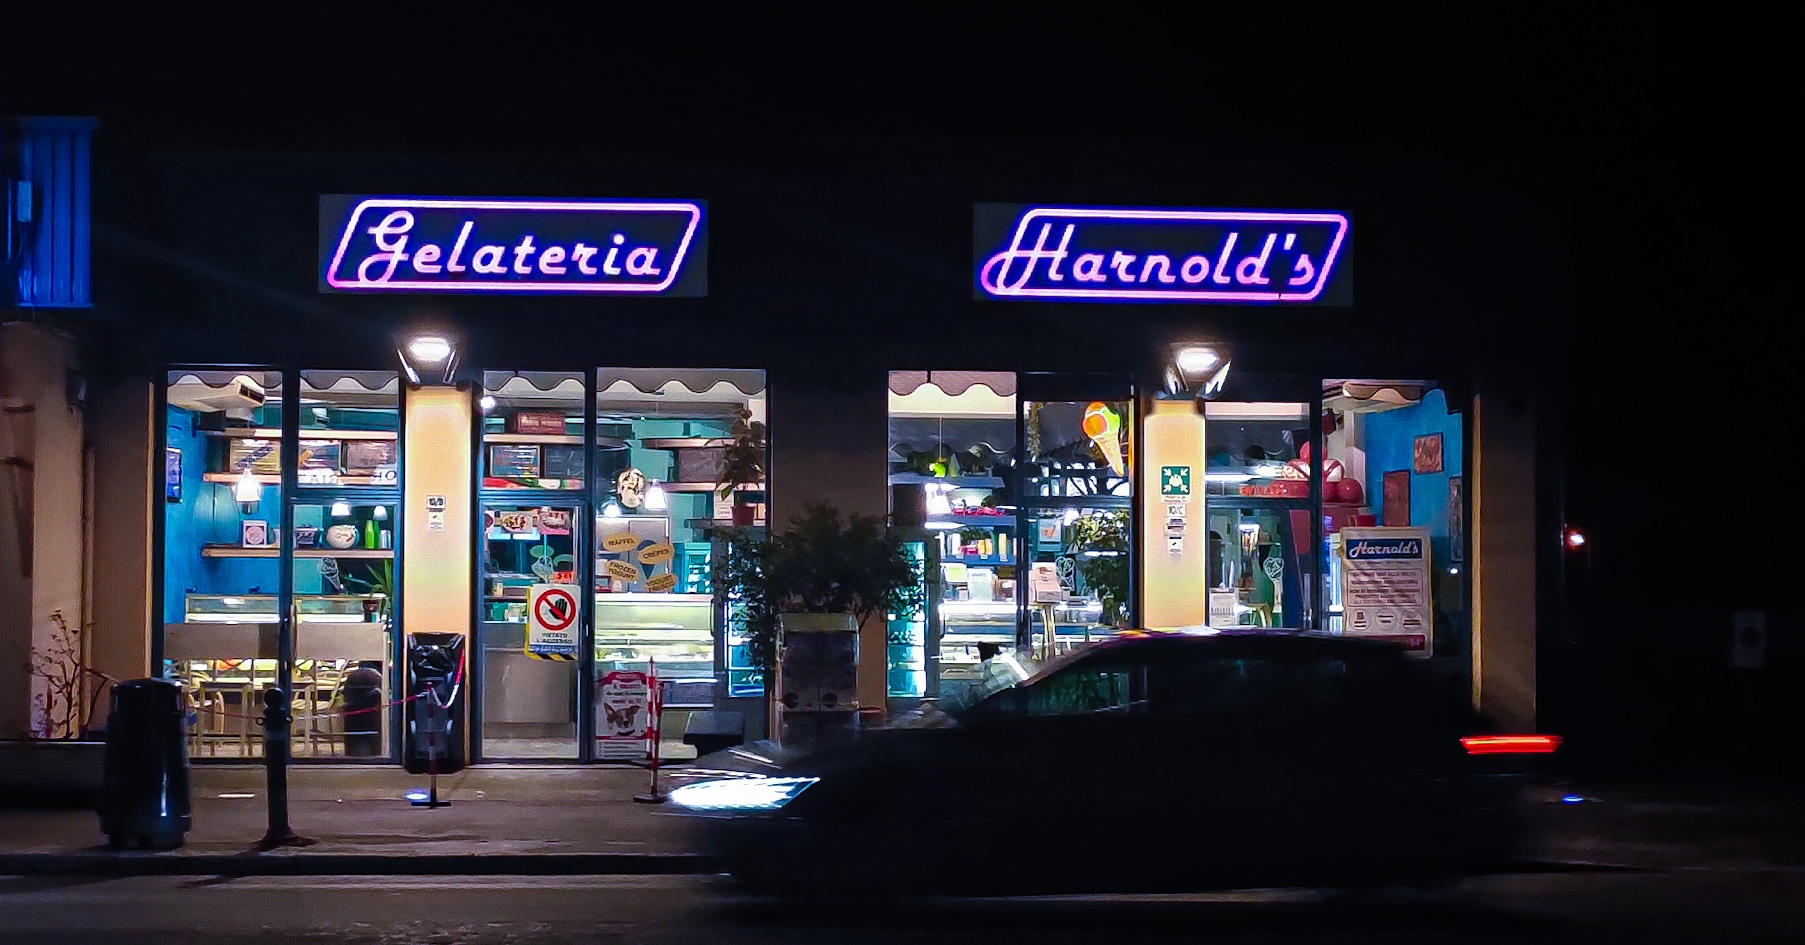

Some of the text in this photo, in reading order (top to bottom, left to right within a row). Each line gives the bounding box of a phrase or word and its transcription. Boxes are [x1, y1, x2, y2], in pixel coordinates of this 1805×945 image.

[357, 210, 661, 284] Gelateria
[981, 222, 1315, 295] Harnold's
[1348, 541, 1419, 558] Harnold's
